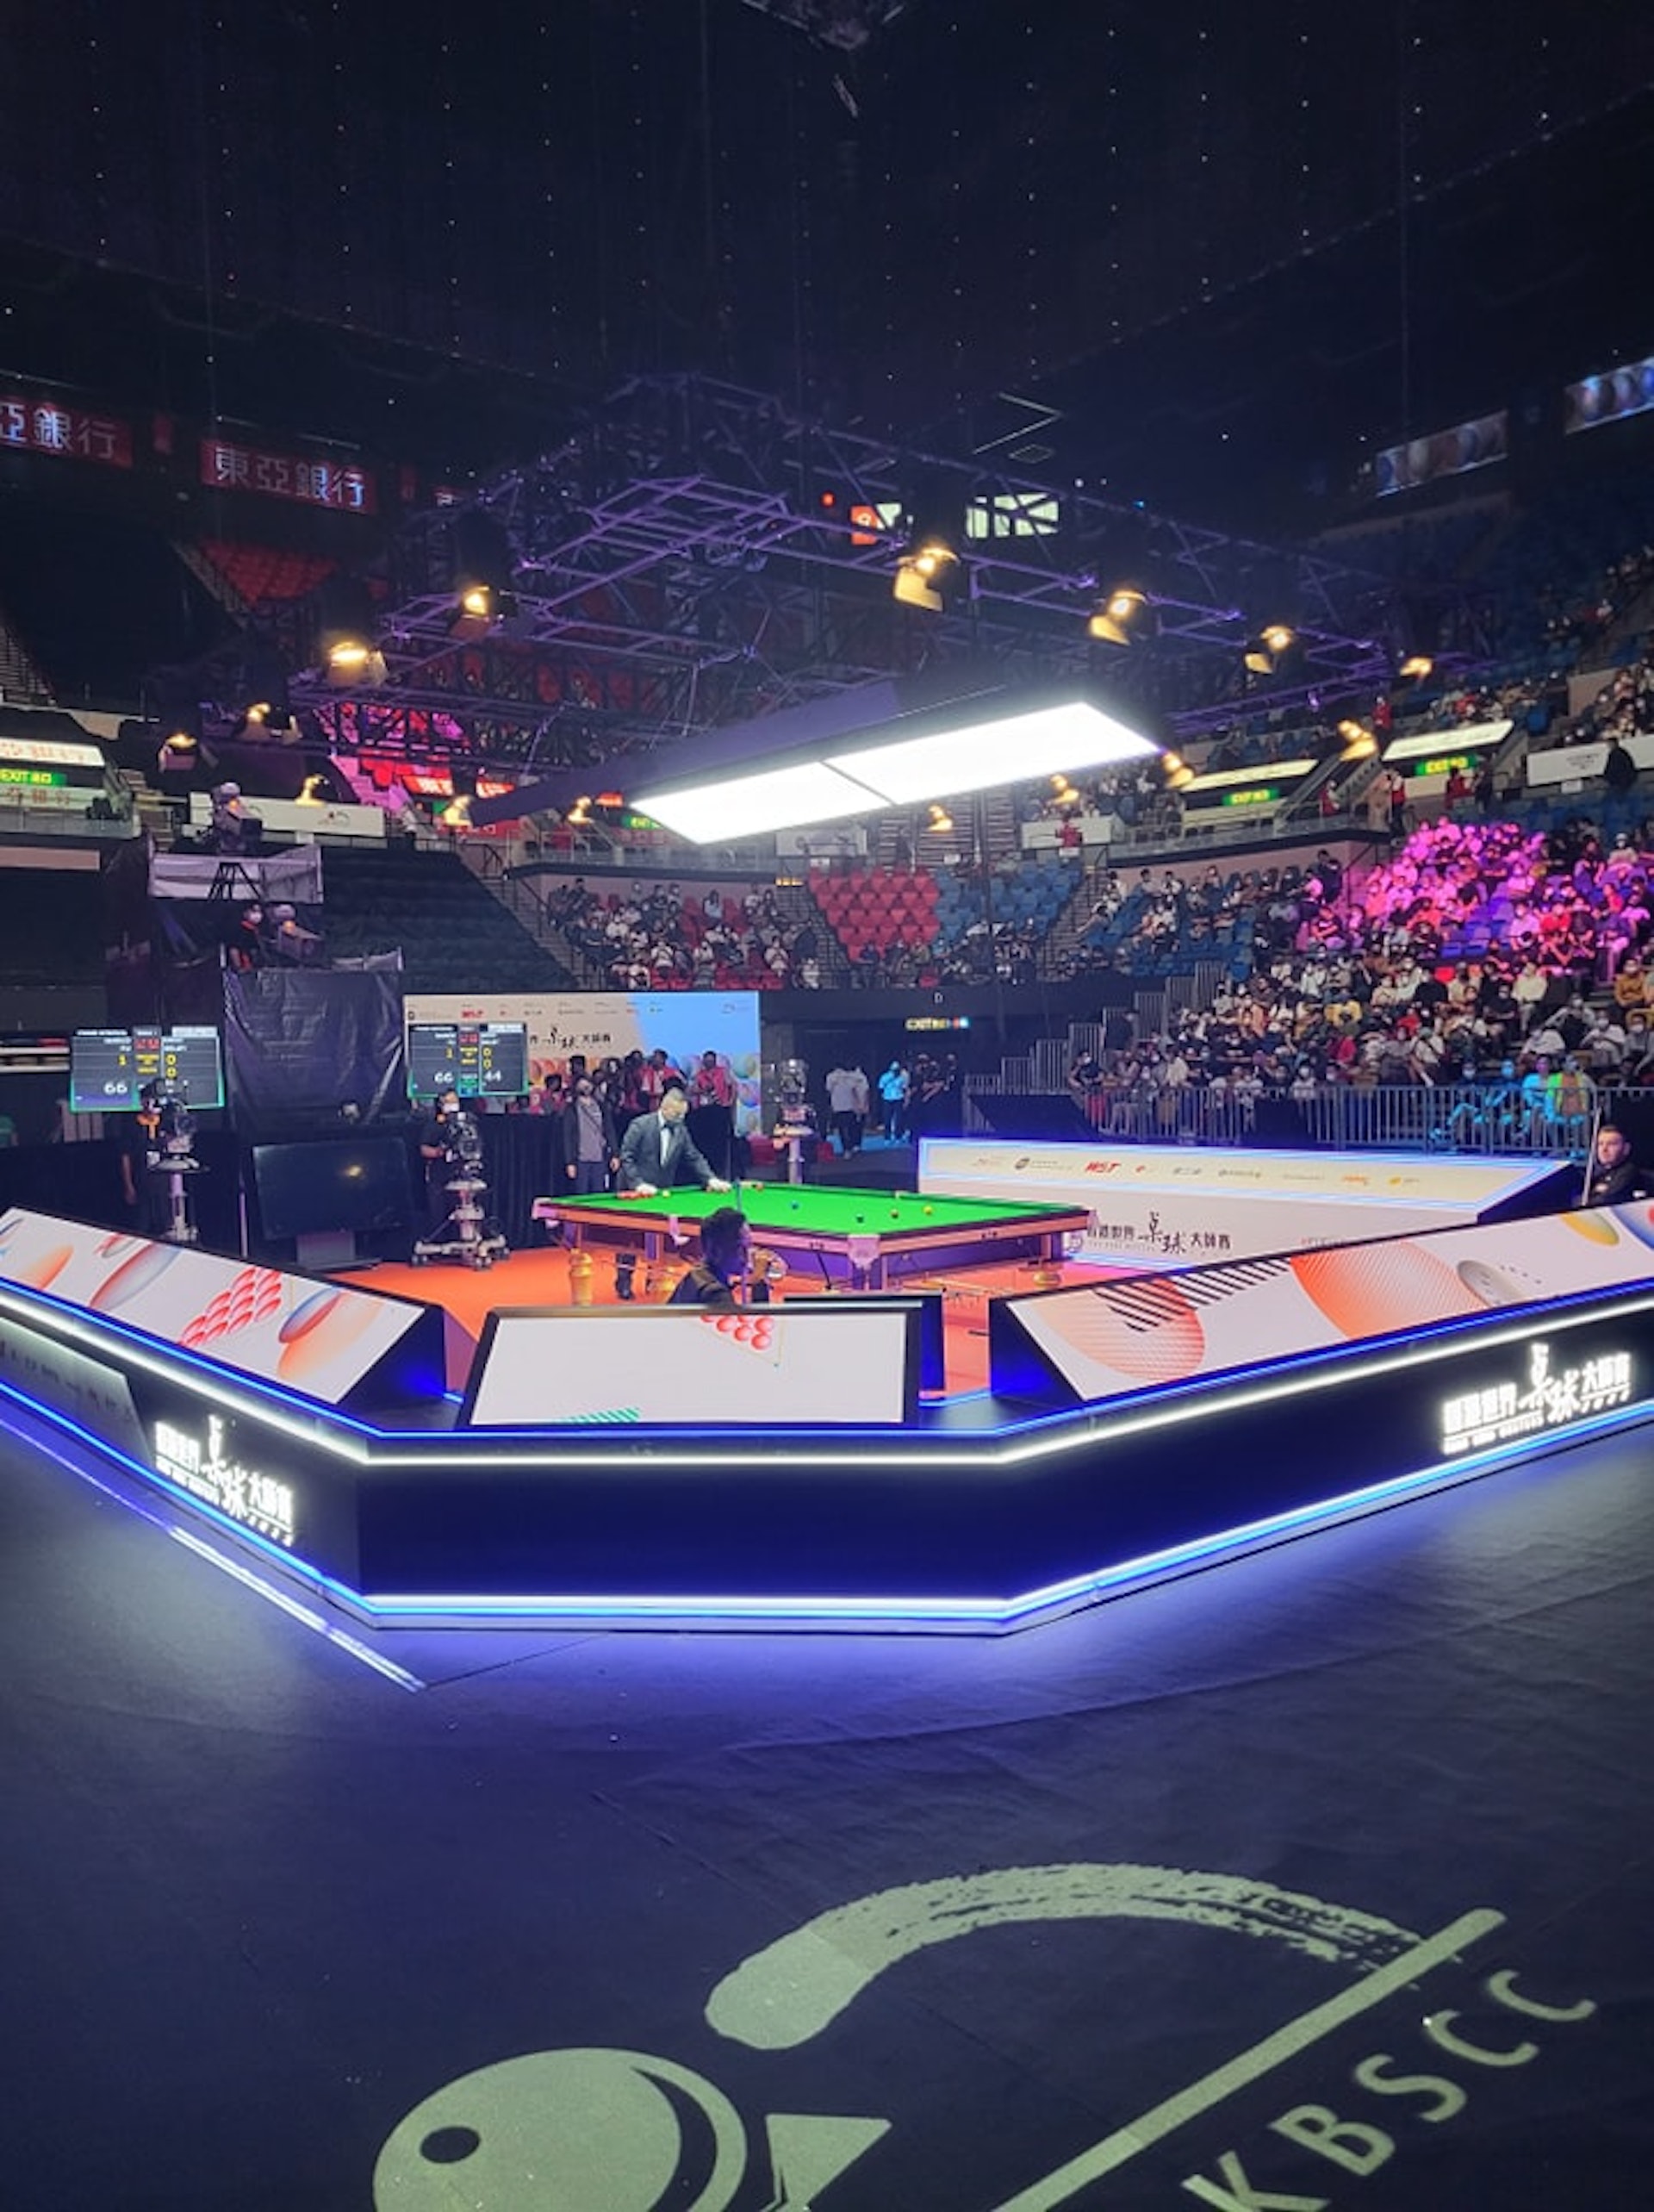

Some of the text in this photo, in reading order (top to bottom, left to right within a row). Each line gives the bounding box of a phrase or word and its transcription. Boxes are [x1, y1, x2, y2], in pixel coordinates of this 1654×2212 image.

[215, 446, 364, 507] 東亞銀行
[103, 1081, 127, 1094] 66
[1085, 1161, 1121, 1173] WST
